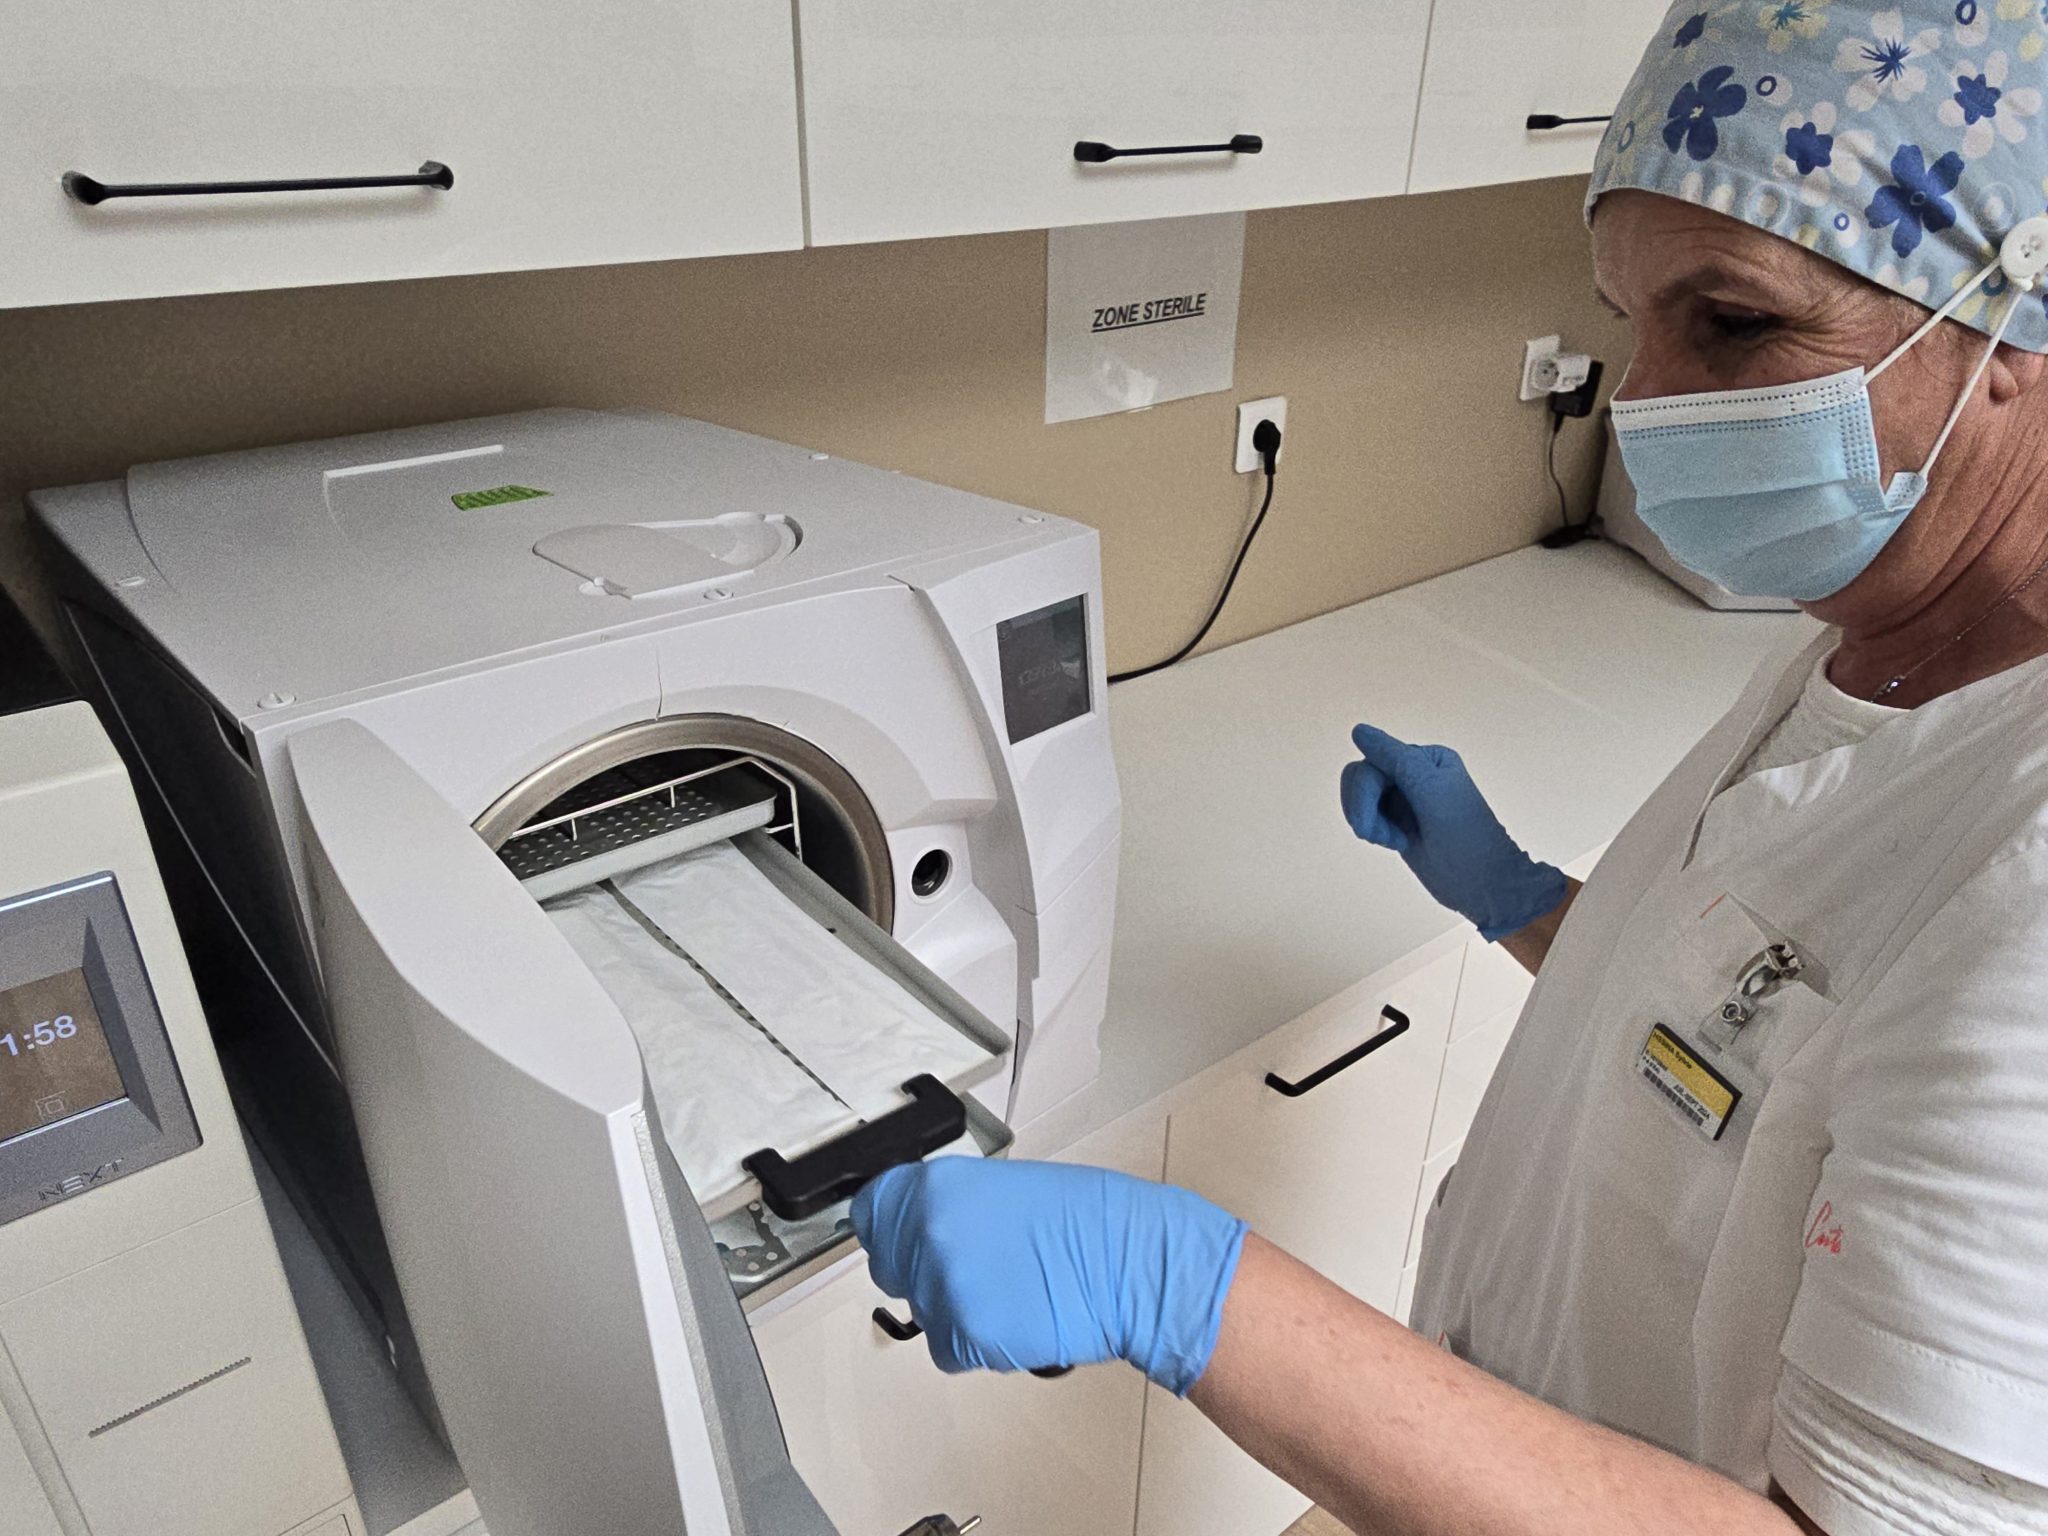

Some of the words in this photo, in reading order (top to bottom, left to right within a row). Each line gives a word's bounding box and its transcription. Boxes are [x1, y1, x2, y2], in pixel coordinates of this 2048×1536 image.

[1092, 303, 1140, 328] ZONE
[1143, 293, 1207, 320] STERILE
[0, 1015, 77, 1056] 1:58
[38, 1157, 124, 1201] NEXT
